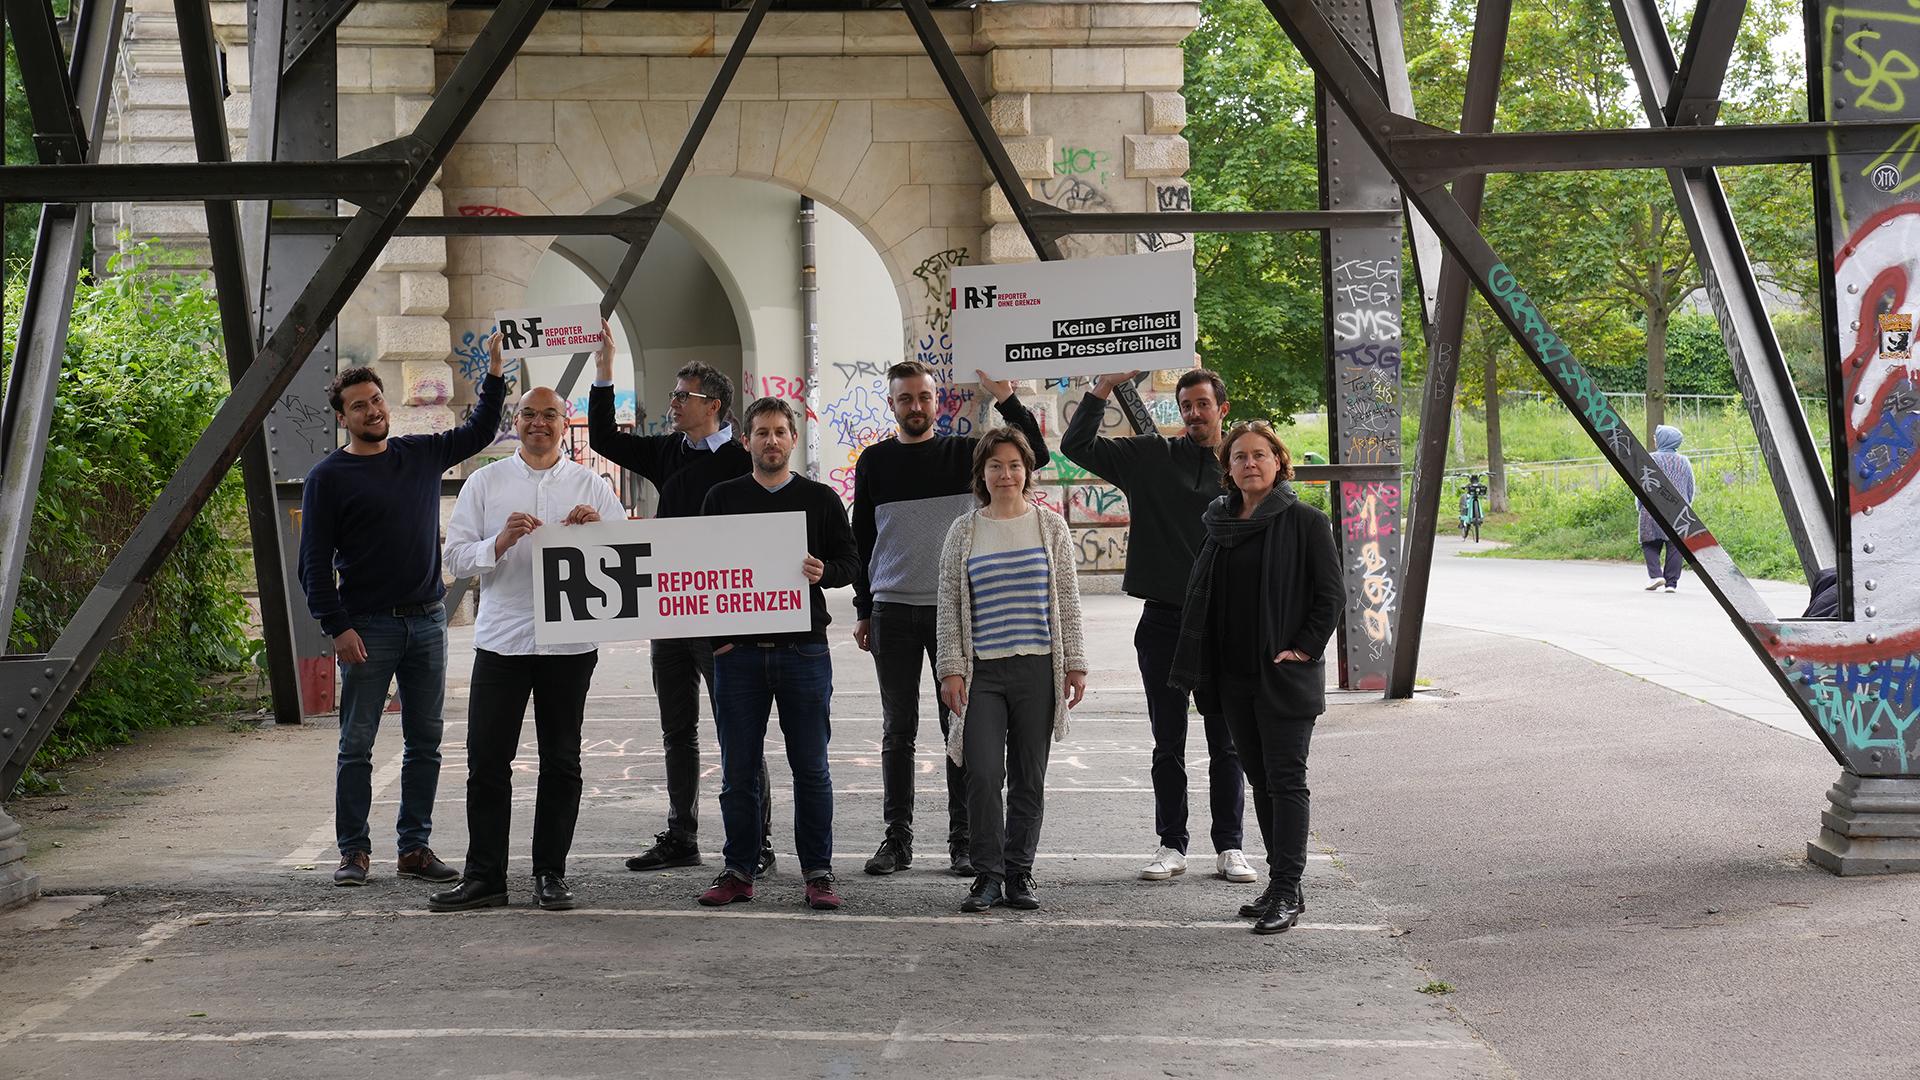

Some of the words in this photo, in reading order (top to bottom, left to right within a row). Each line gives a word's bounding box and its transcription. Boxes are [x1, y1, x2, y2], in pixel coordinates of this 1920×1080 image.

[1332, 259, 1400, 293] TSG
[965, 285, 997, 310] RSF
[998, 292, 1027, 301] REPORTER
[998, 299, 1014, 308] OHNE
[1015, 298, 1041, 307] GRENZEN
[1337, 281, 1392, 307] TSG
[499, 317, 544, 351] RSF
[544, 326, 583, 337] REPORTER
[1056, 320, 1106, 336] Keine
[1111, 313, 1177, 331] Freiheit
[1334, 309, 1401, 340] SMS
[546, 337, 567, 347] OHNE
[568, 333, 603, 345] GRENZEN
[1009, 344, 1053, 360] ohne
[1058, 334, 1177, 357] Pressefreiheit
[1336, 342, 1401, 380] TSG
[762, 376, 805, 403] 1312
[1118, 381, 1158, 434] NSPOR
[542, 543, 653, 623] RSF
[657, 568, 754, 592] REPORTER
[659, 595, 710, 617] OHNE
[716, 589, 803, 614] GRENZEN
